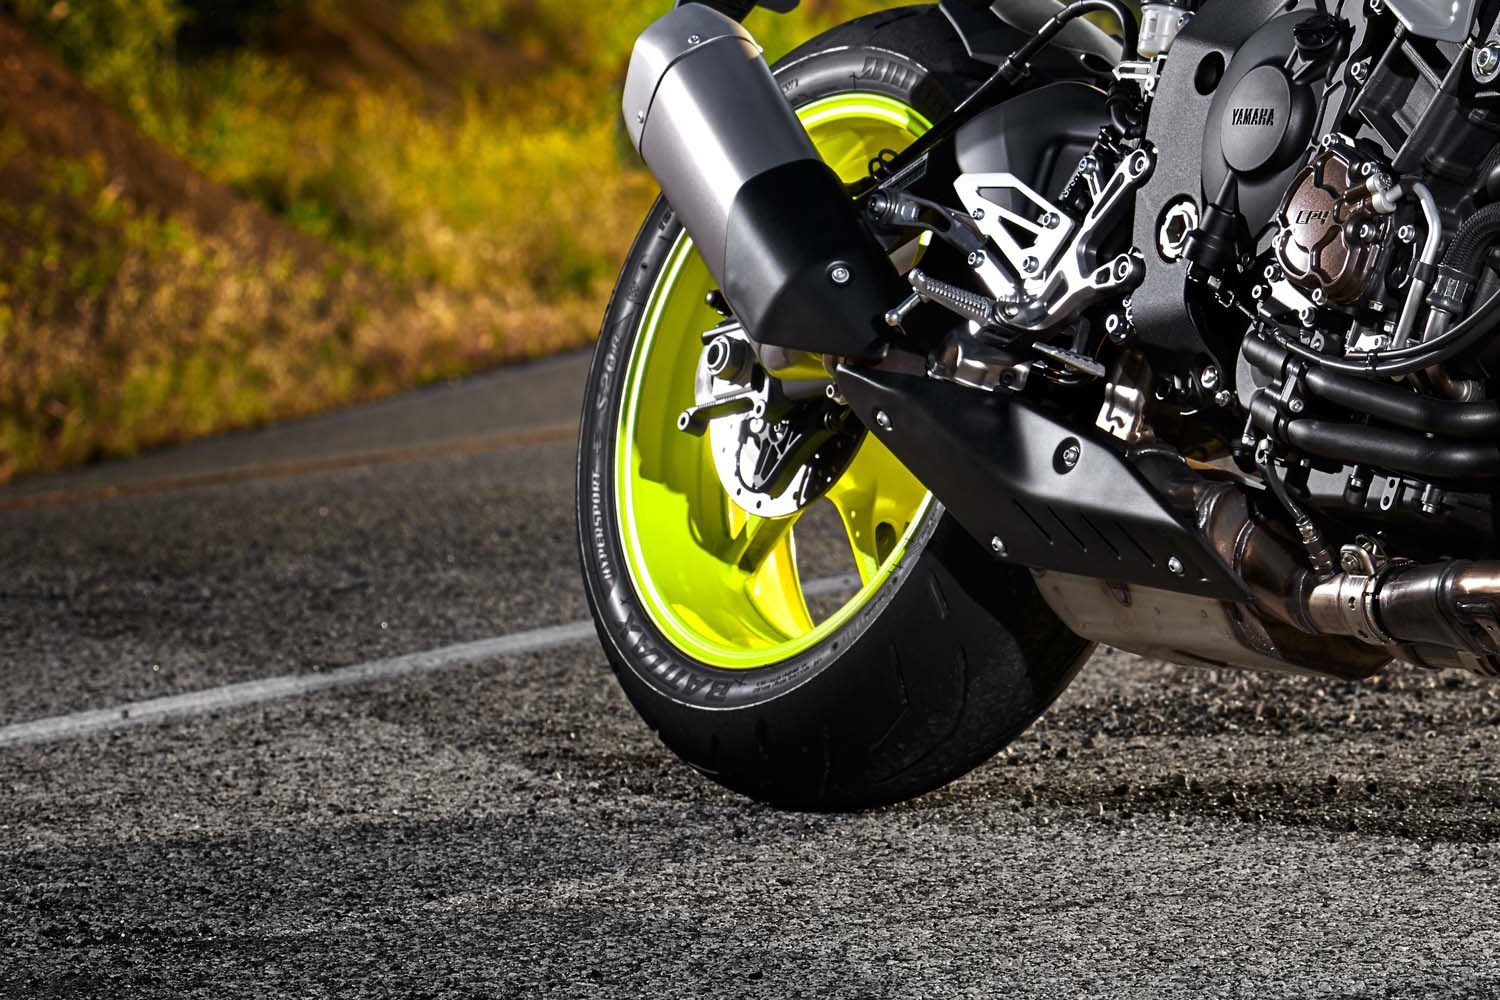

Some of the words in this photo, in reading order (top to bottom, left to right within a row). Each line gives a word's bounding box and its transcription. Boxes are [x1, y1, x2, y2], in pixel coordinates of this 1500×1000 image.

[1231, 107, 1275, 126] YAMAHA
[1295, 210, 1330, 224] CP4
[592, 472, 612, 579] HYPERSPORT
[616, 609, 735, 703] BATTLAX
